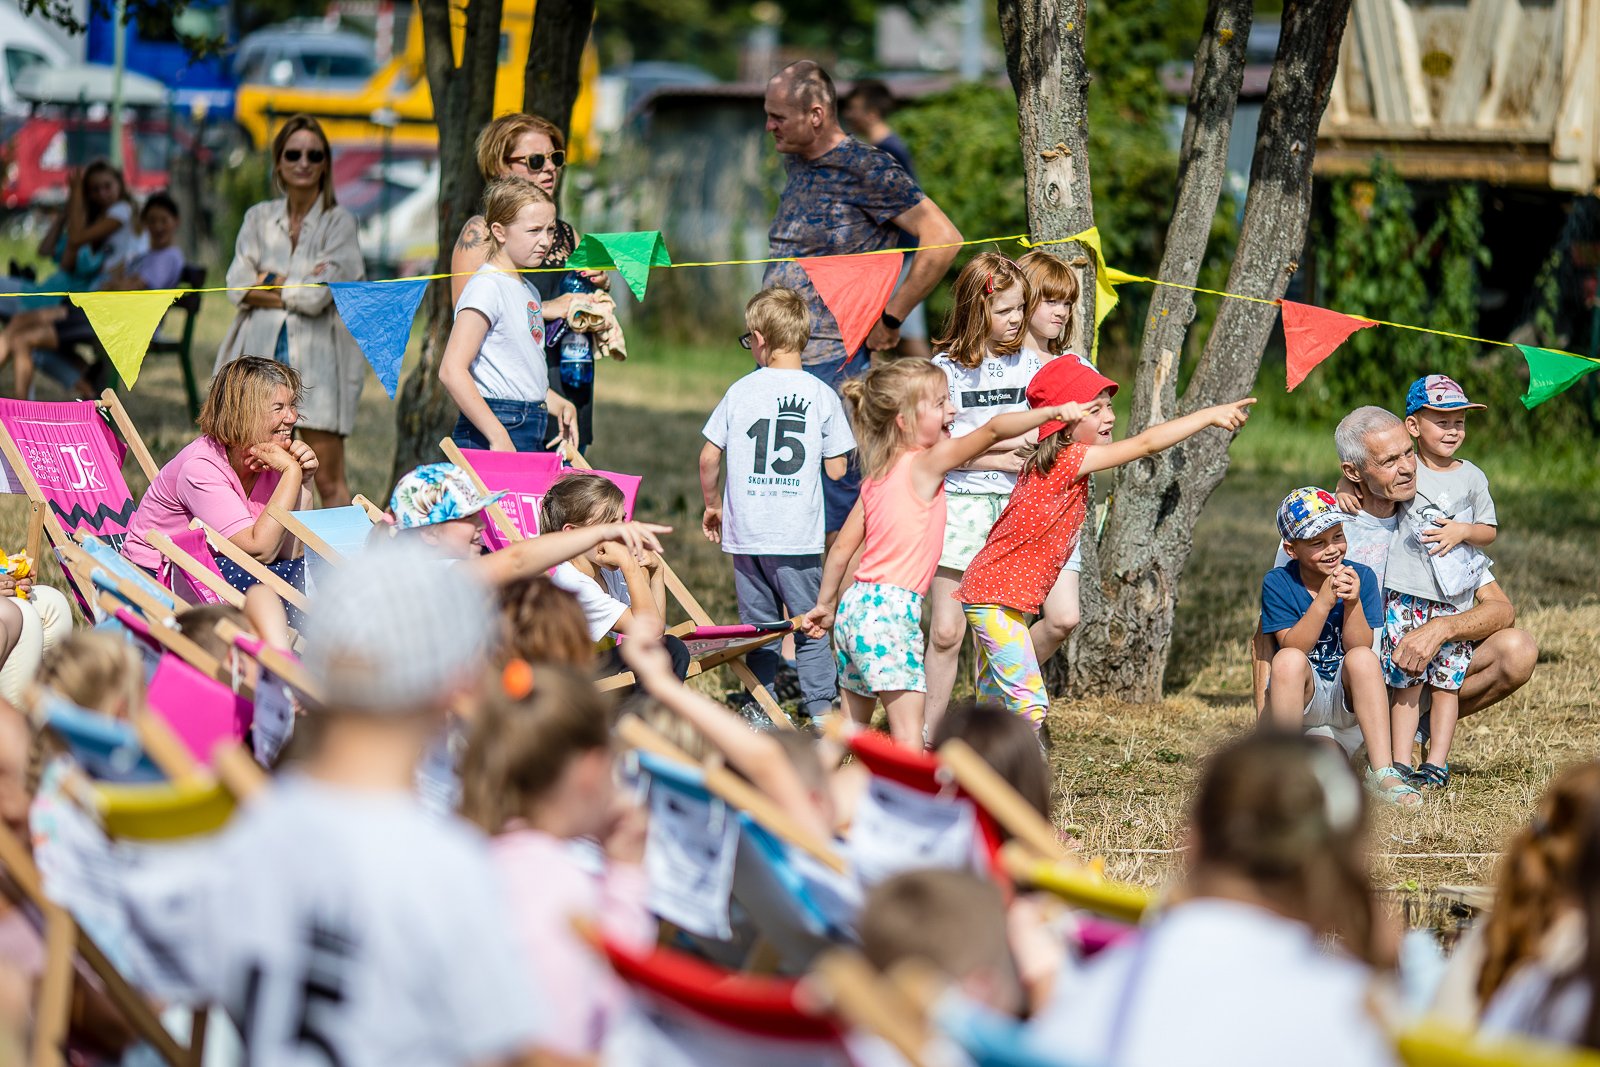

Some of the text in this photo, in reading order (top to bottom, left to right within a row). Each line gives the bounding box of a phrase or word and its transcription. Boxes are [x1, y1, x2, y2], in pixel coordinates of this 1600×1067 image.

[746, 418, 806, 475] 15
[748, 475, 768, 485] SKOKI
[775, 477, 800, 487] MIASTO
